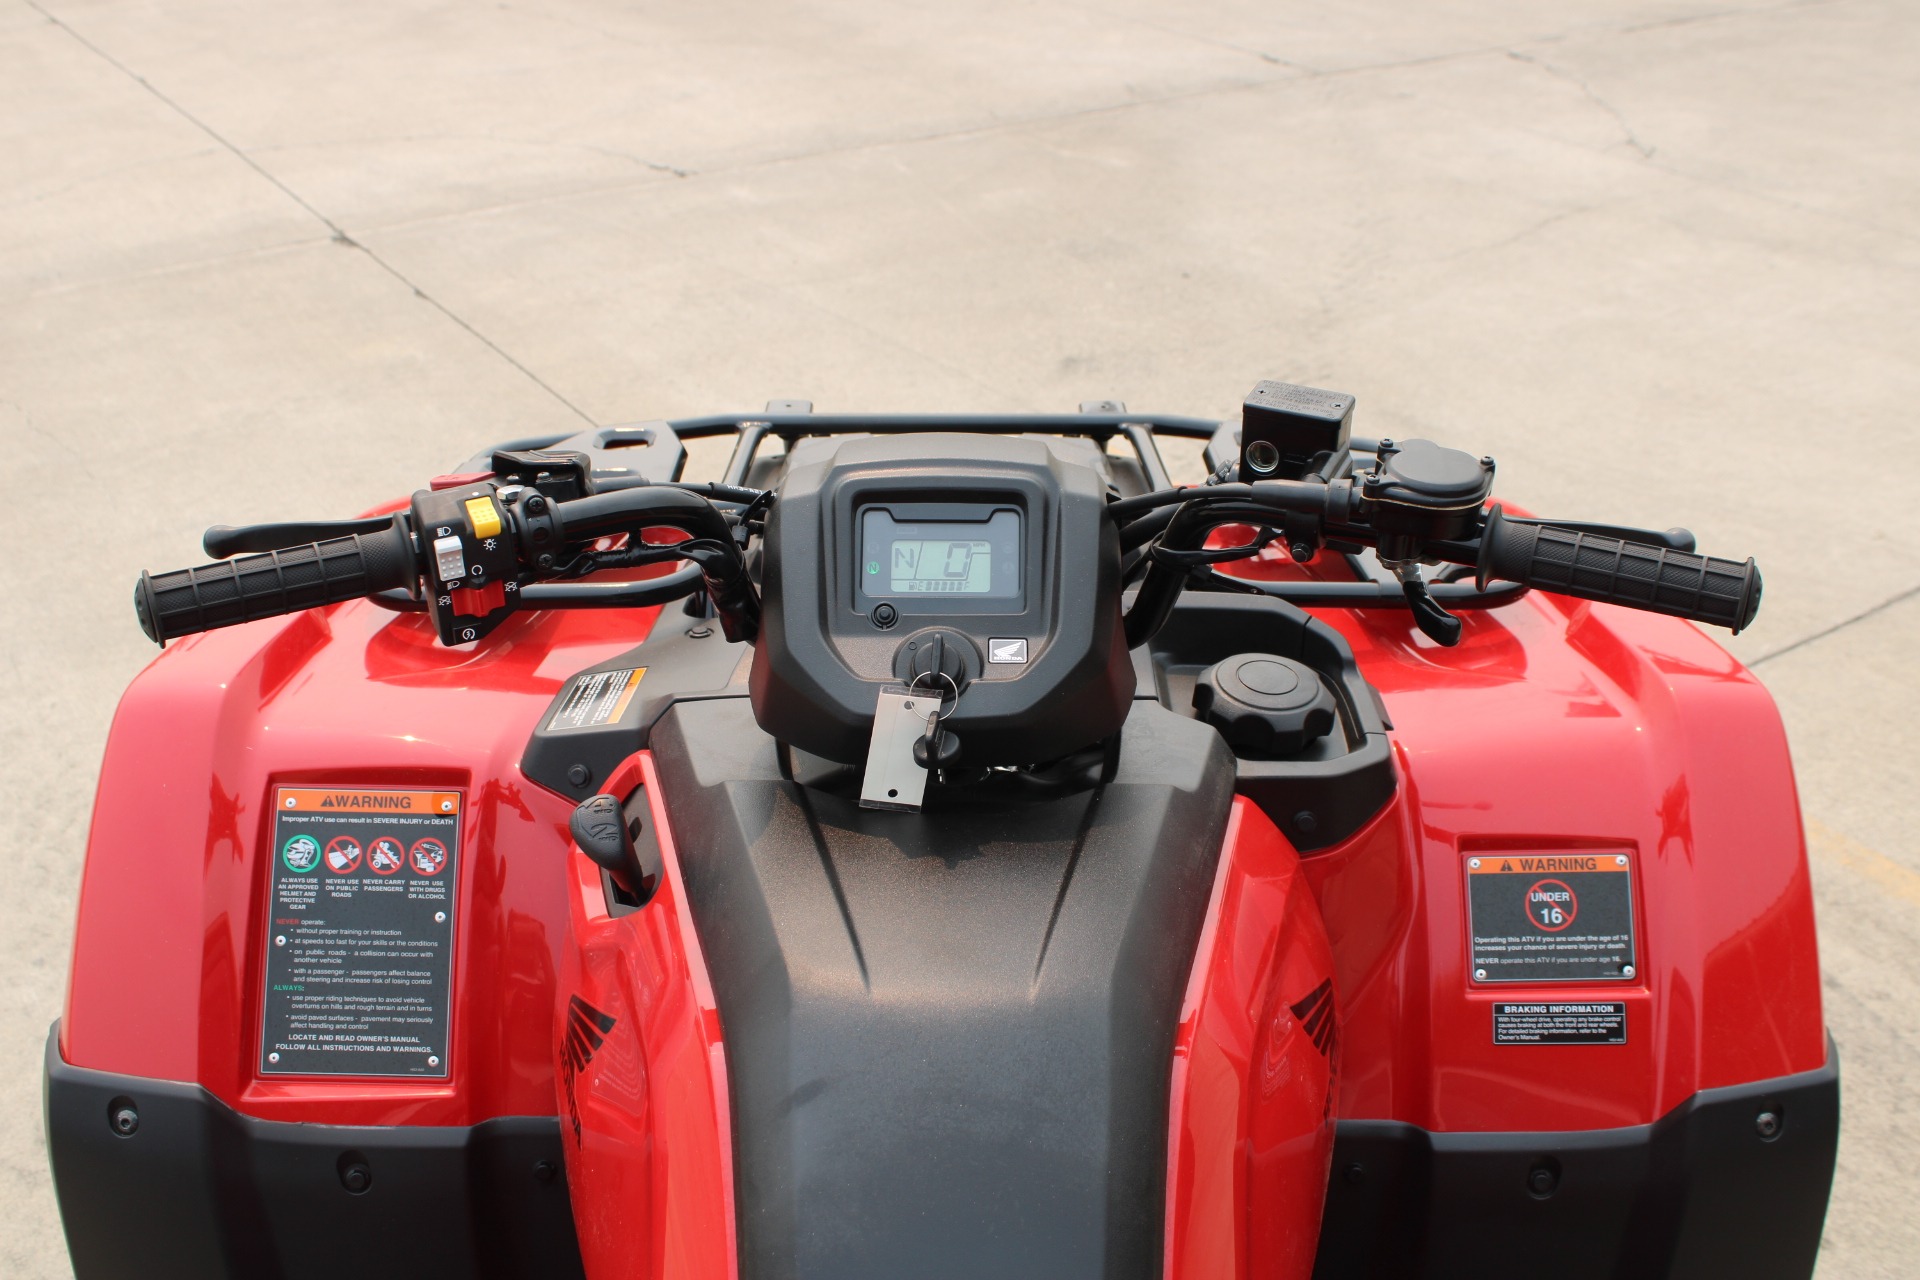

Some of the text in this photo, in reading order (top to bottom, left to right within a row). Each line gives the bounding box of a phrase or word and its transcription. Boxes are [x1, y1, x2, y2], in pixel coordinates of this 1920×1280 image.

[895, 542, 972, 578] N 0
[335, 795, 411, 808] WARNING
[1520, 858, 1597, 871] WARNING
[1530, 892, 1570, 902] UNDER
[1540, 908, 1562, 924] 16
